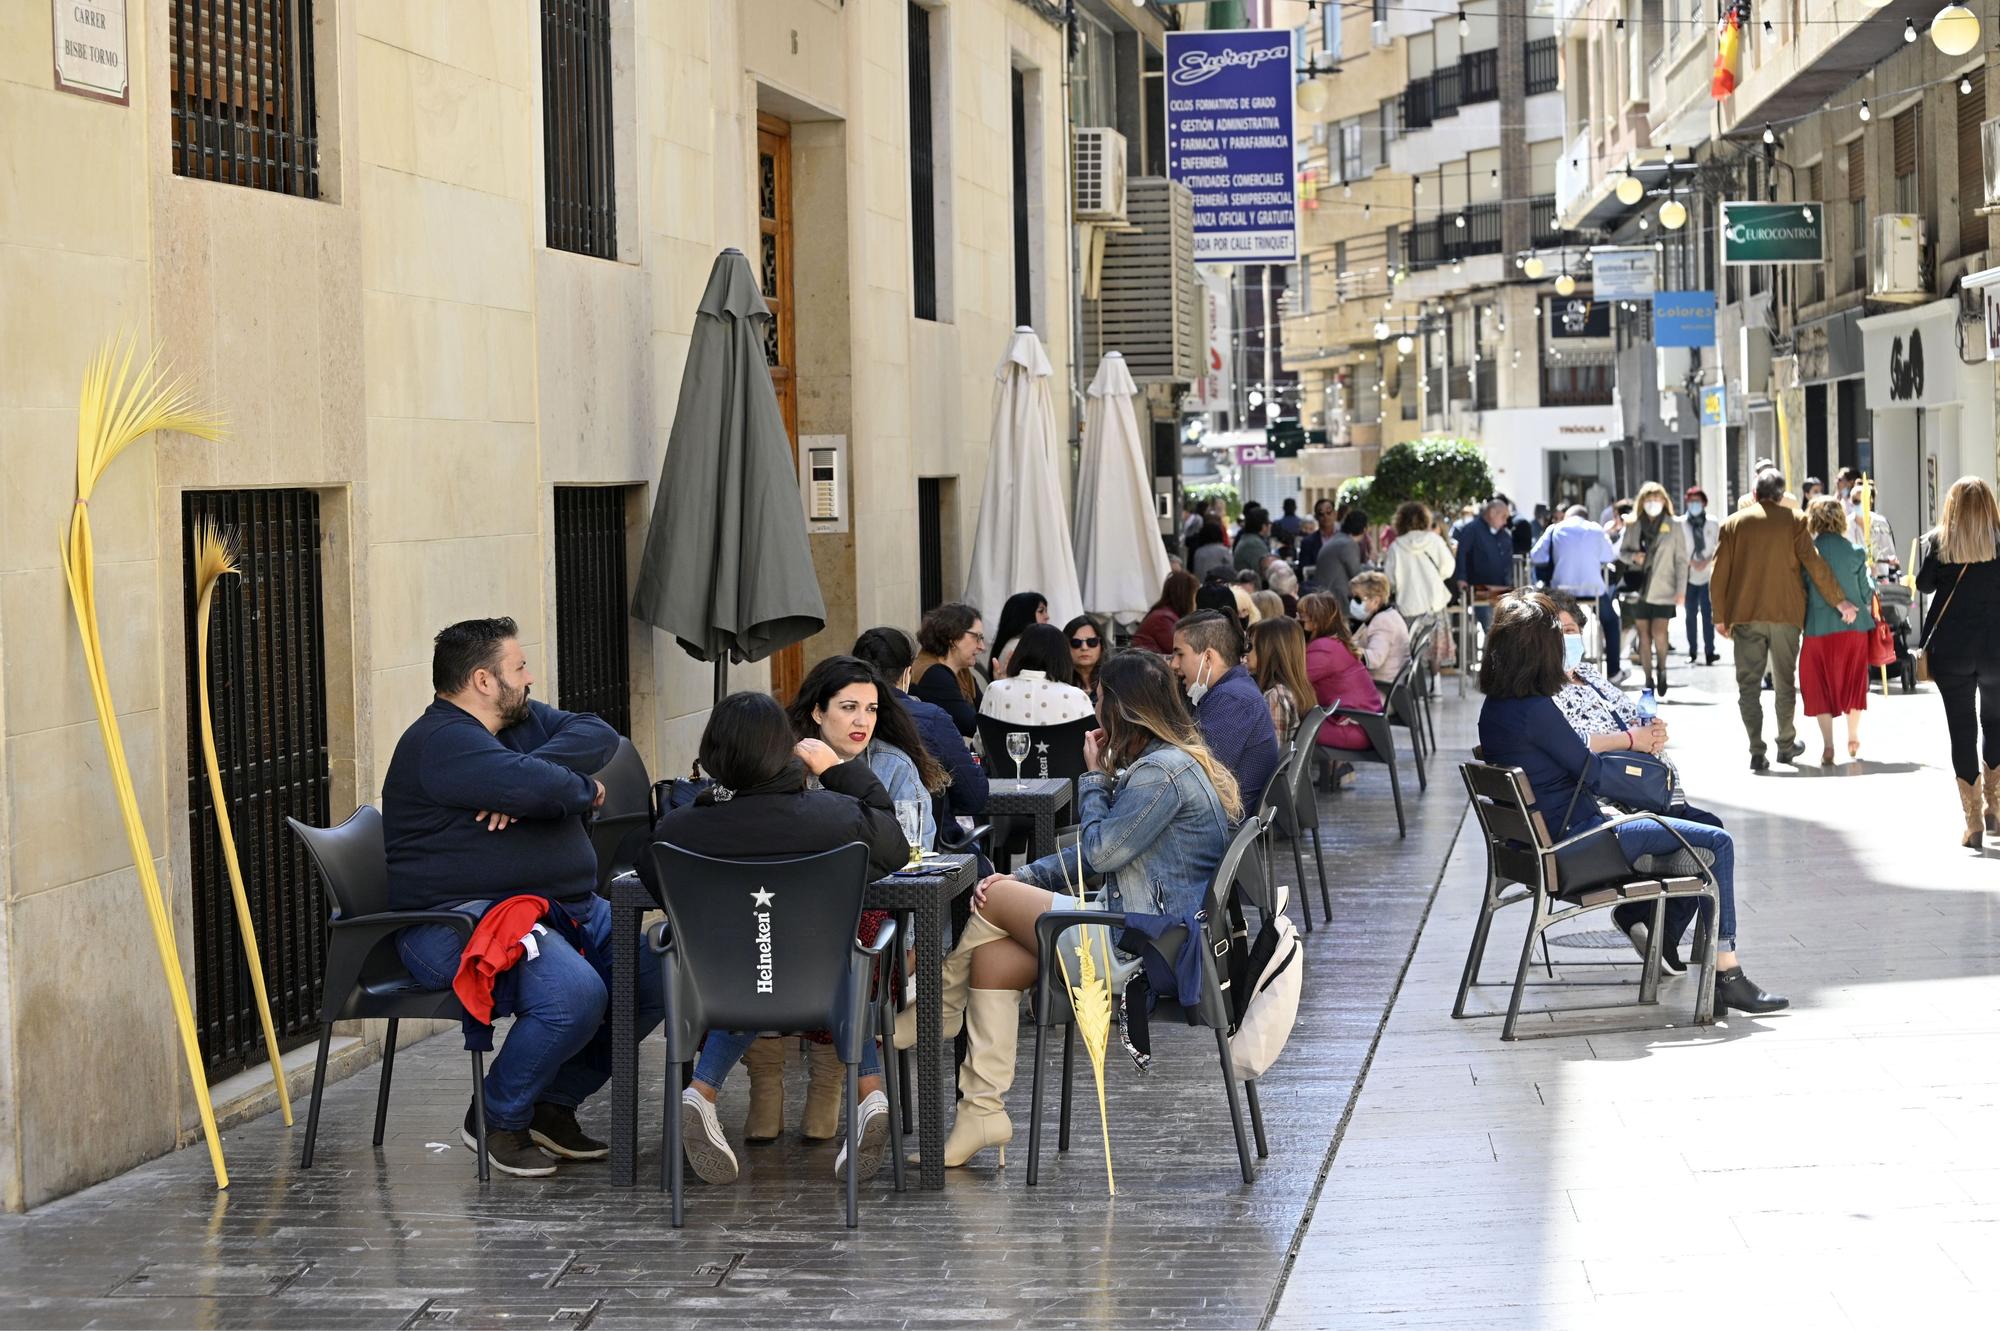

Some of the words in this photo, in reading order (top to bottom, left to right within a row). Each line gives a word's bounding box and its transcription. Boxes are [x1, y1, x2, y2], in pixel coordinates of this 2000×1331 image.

[74, 6, 106, 30] CARRER
[64, 39, 88, 60] BISBE
[89, 46, 118, 68] TORMO
[1171, 46, 1289, 85] Europa
[1170, 99, 1194, 111] CICLOS
[1195, 98, 1239, 111] FORMATIVOS
[1239, 97, 1250, 109] DE
[1251, 97, 1276, 109] GRADO
[1181, 117, 1214, 132] GESTIÓN
[1216, 117, 1280, 131] ADMINISTRATIVA
[1180, 138, 1219, 151] FARMACIA
[1221, 137, 1228, 150] Y
[1229, 135, 1288, 149] PARAFARMACIA
[1181, 154, 1228, 170] ENFERMERÍA
[1182, 174, 1231, 188] ACTIVIDADES
[1232, 173, 1284, 187] COMERCIALES
[1231, 191, 1293, 206] SEMIPRESENCIAL
[1218, 211, 1248, 226] OFICIAL
[1249, 210, 1256, 225] Y
[1257, 210, 1295, 225] GRATUITA
[1213, 238, 1226, 250] POR
[1230, 237, 1252, 250] CALLE
[1254, 236, 1289, 251] TRINQUET
[755, 911, 773, 994] Heineken
